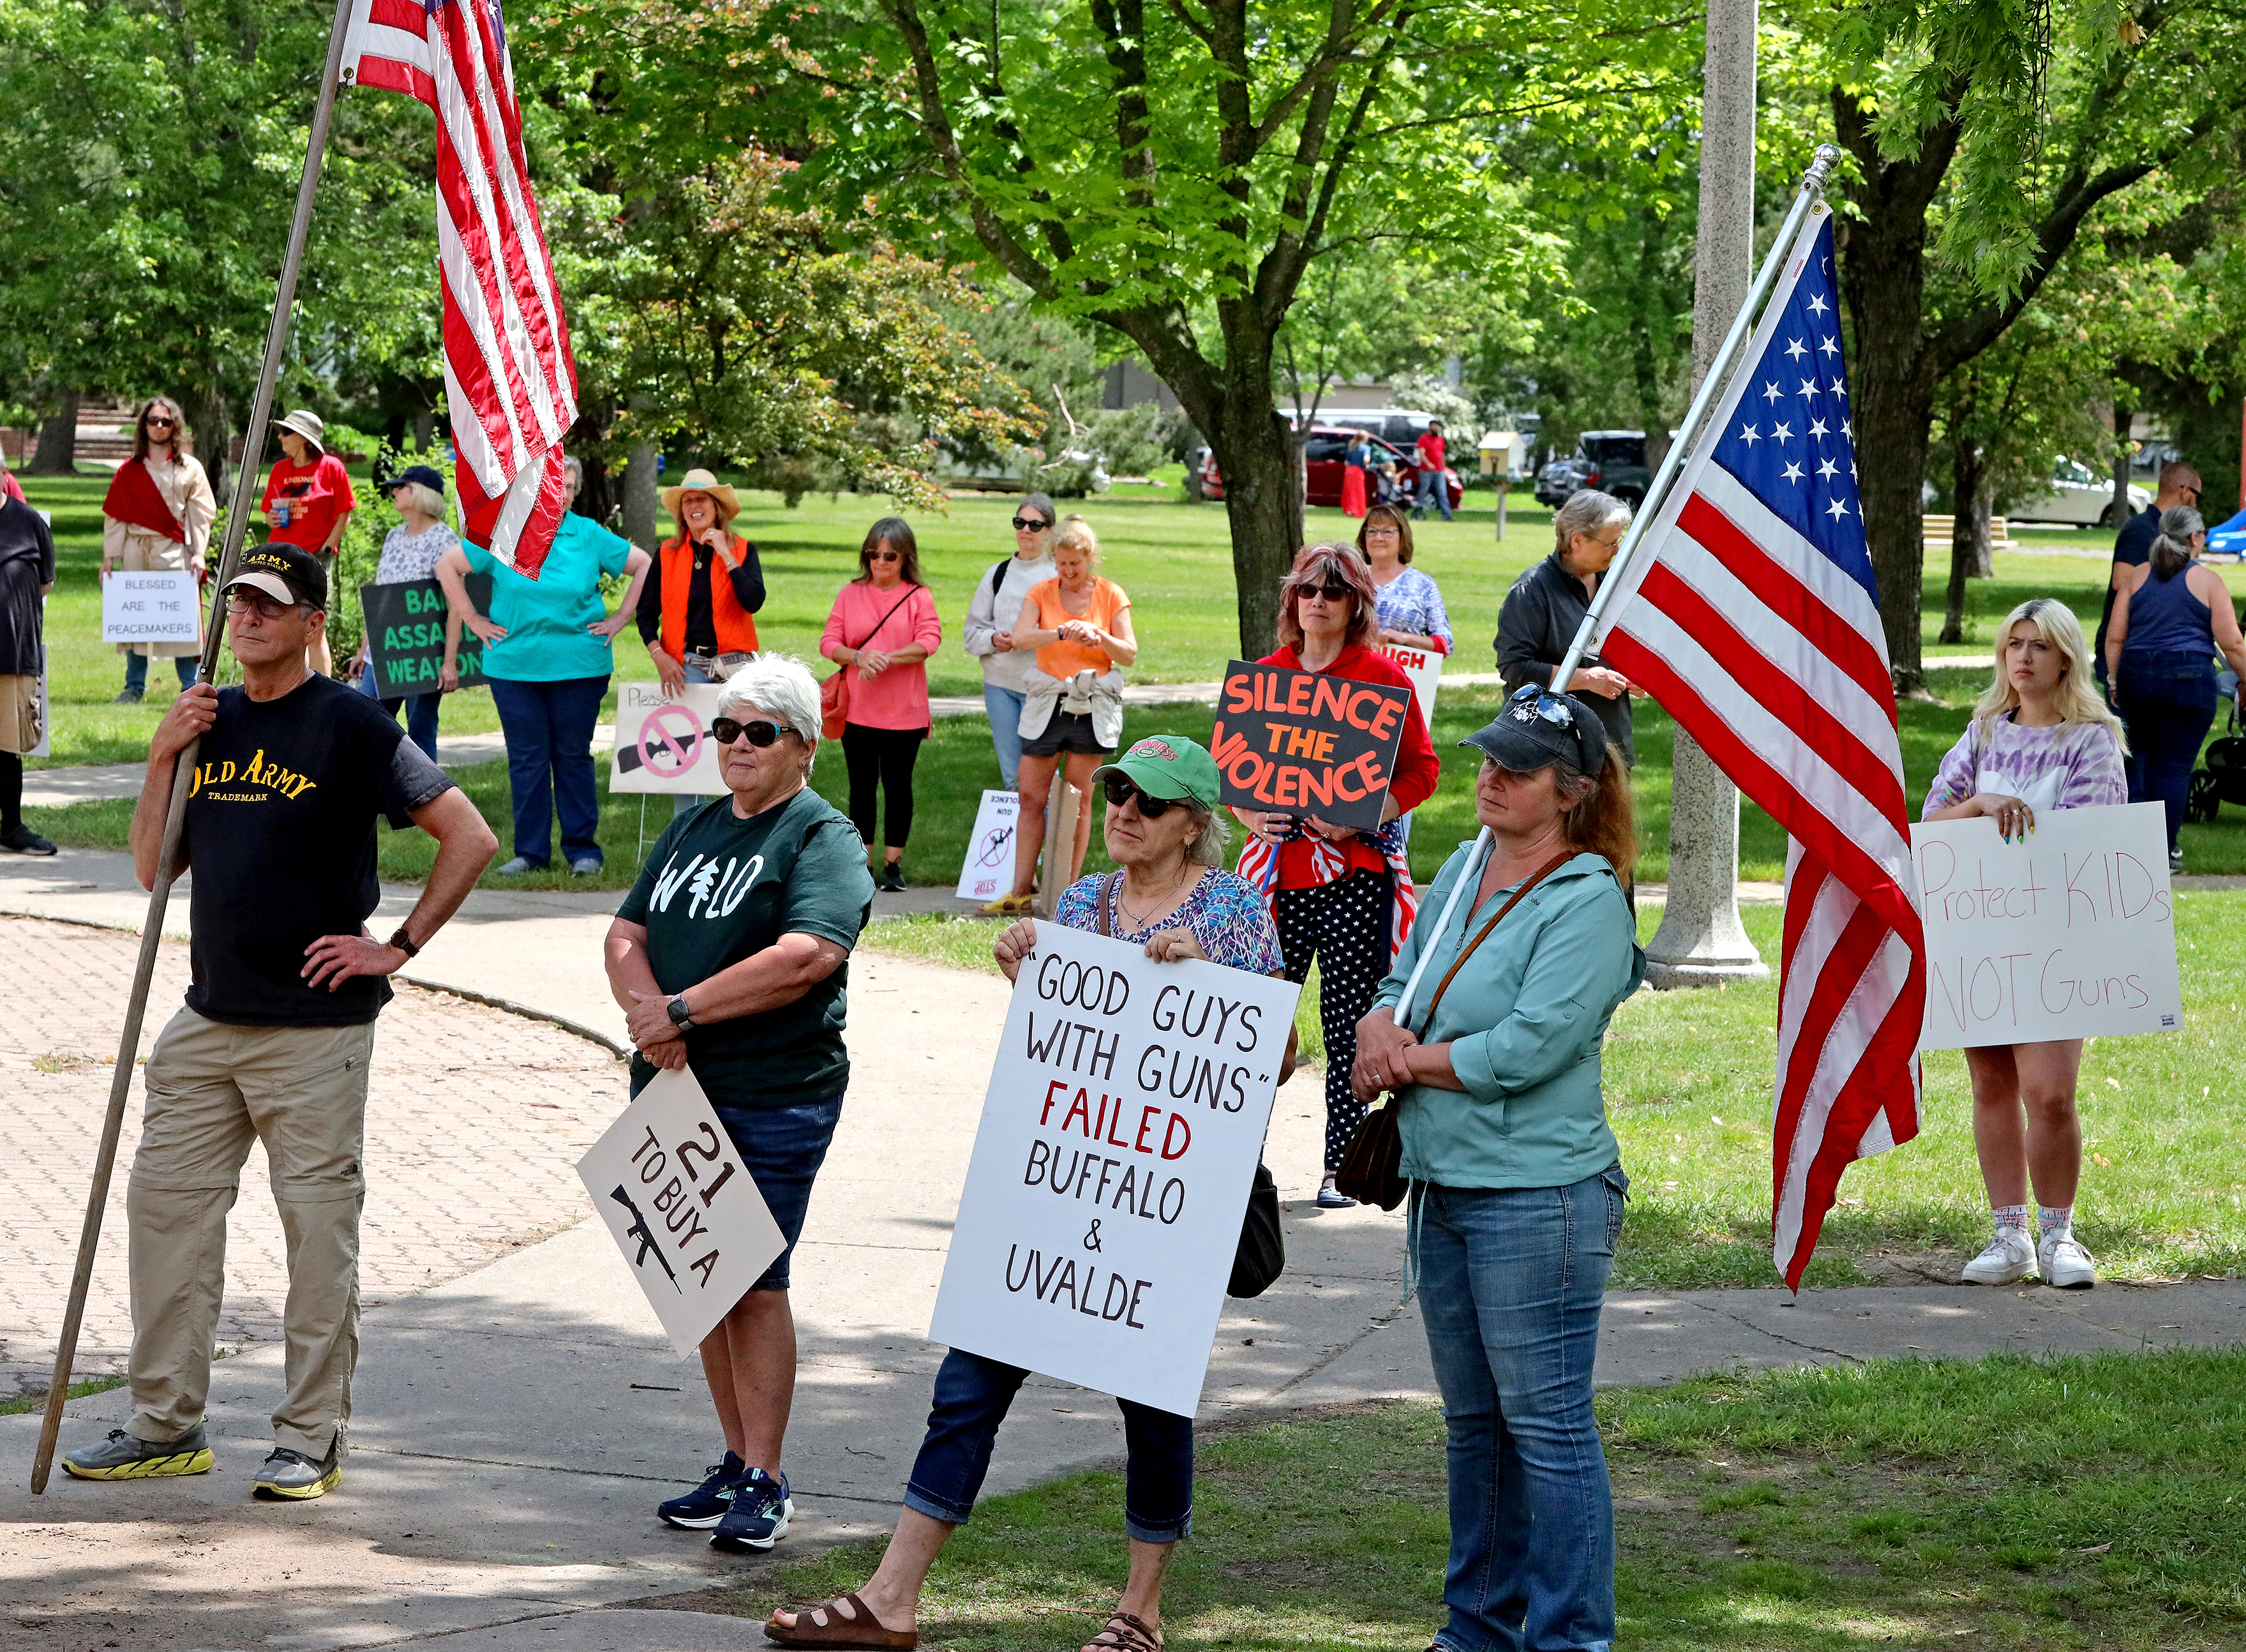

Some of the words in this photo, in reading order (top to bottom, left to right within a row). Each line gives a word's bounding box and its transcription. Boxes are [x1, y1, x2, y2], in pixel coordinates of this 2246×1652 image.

[125, 580, 176, 590] BLESSED
[247, 553, 292, 571] ARMY
[267, 562, 284, 571] STATES
[108, 623, 191, 634] PEACEMAKERS
[121, 601, 146, 612] ARE
[158, 601, 180, 611] THE
[628, 687, 670, 707] Please
[1225, 672, 1405, 740] SILENCE
[1209, 721, 1388, 807] VIOLENCE
[1265, 722, 1340, 763] THE
[208, 792, 268, 802] TRADEMARK
[246, 749, 317, 800] ARMY
[975, 881, 996, 894] STOP
[1920, 841, 2046, 925] Protect
[1028, 950, 1129, 1016] "GOOD
[1153, 984, 1262, 1053] GUYS
[1930, 953, 2032, 1032] NOT
[2040, 949, 2148, 1014] Guns
[1026, 1010, 1119, 1081] WITH
[1137, 1044, 1270, 1113] GUNS"
[1040, 1079, 1192, 1160] FAILED
[676, 1121, 736, 1208] 21
[1024, 1139, 1185, 1225] BUFFALO
[631, 1125, 666, 1184] TO
[653, 1176, 709, 1249] BUY
[690, 1249, 720, 1289] A
[1083, 1218, 1103, 1253] &
[1005, 1243, 1153, 1330] UVALDE
